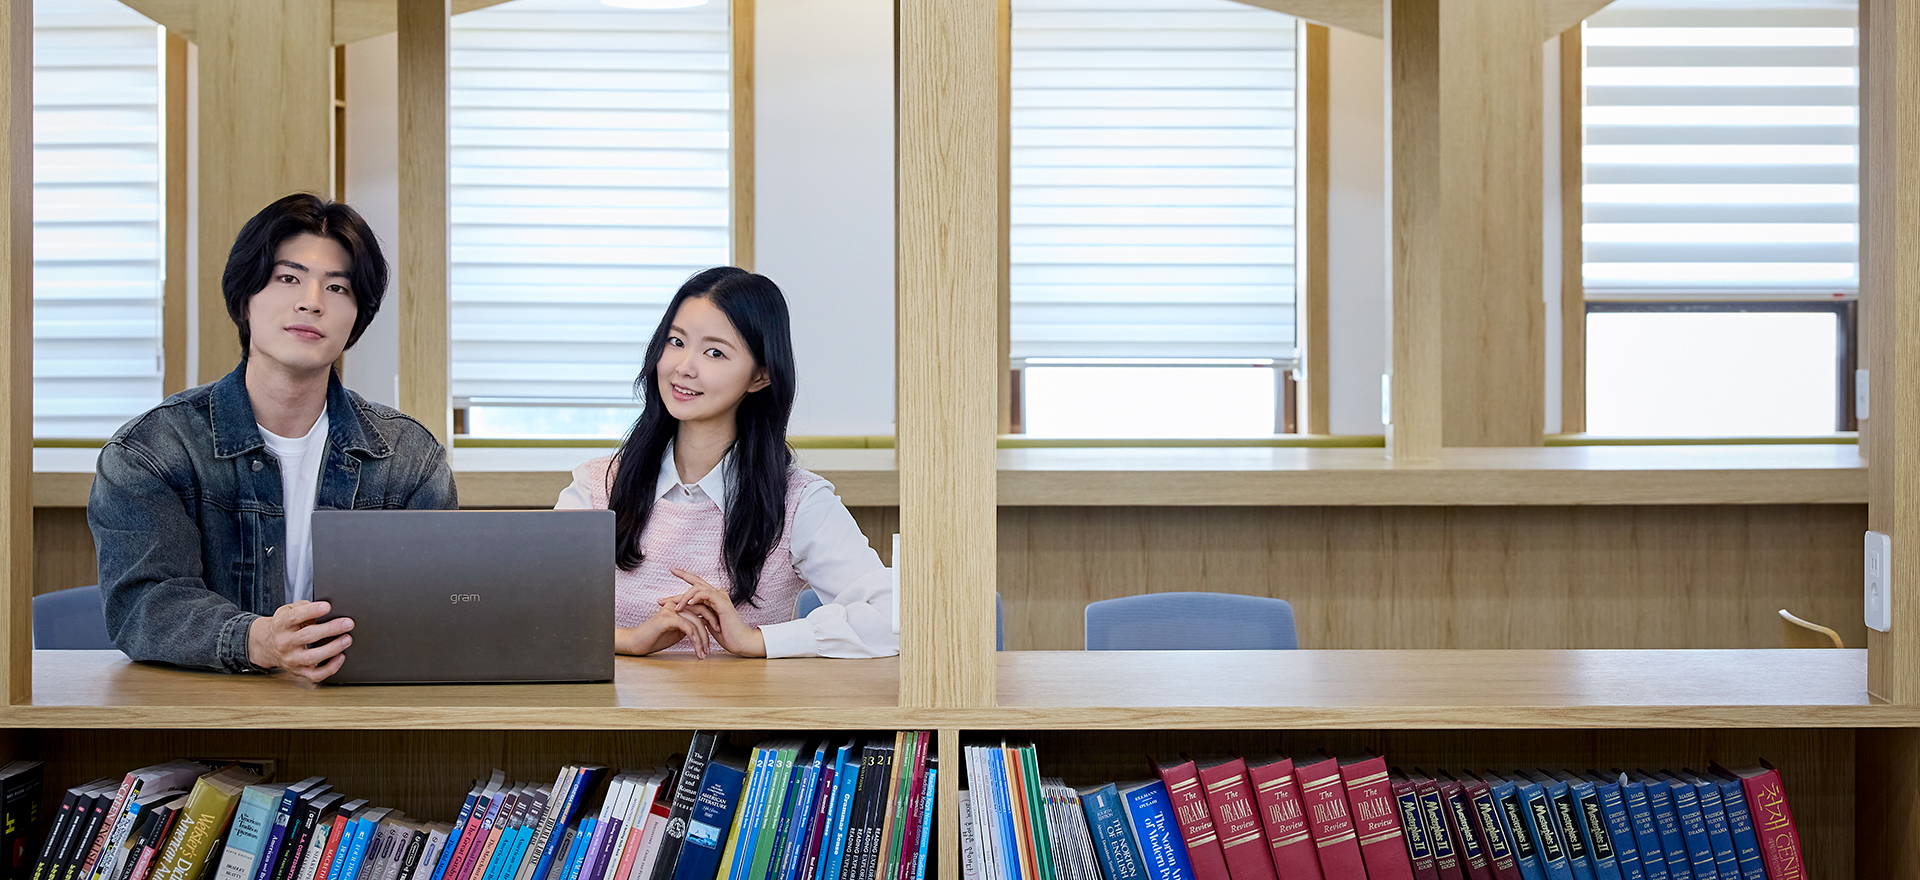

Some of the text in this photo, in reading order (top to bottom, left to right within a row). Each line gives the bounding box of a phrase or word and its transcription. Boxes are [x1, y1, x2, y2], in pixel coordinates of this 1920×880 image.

[450, 593, 481, 605] gram
[694, 751, 704, 760] The
[756, 759, 763, 768] 2
[767, 759, 774, 768] 2
[775, 759, 782, 768] 3
[785, 760, 792, 768] 3
[813, 760, 821, 768] 2
[868, 756, 875, 766] 3
[877, 755, 884, 765] 2
[886, 755, 892, 766] 1
[685, 771, 700, 780] Greek
[825, 779, 831, 787] 1
[921, 771, 929, 795] Reading
[927, 772, 935, 796] Reading
[106, 780, 130, 820] SCREEN
[567, 783, 579, 803] CINEMA
[680, 785, 697, 795] Roman
[702, 793, 727, 804] AMERICAN
[1096, 794, 1105, 808] 1
[1183, 792, 1197, 801] The
[1225, 791, 1239, 800] The
[1274, 790, 1289, 800] The
[1319, 790, 1333, 800] The
[1364, 788, 1378, 798] The
[699, 796, 727, 810] LITERATURE
[823, 784, 838, 837] Grammar Sense
[1178, 800, 1210, 826] DRAMA
[1220, 798, 1253, 824] DRAMA
[1269, 798, 1303, 824] DRAMA
[1313, 797, 1347, 824] DRAMA
[1358, 795, 1392, 822] DRAMA
[1758, 782, 1790, 832] 천재
[832, 792, 850, 856] Grammar Sense
[1143, 816, 1155, 829] of
[1153, 810, 1168, 832] The
[1190, 822, 1213, 834] Review
[1231, 820, 1255, 833] Review
[1280, 820, 1304, 834] Review
[1324, 820, 1348, 834] Review
[1368, 818, 1393, 831] Review
[1402, 801, 1426, 852] Masterplots II
[1425, 800, 1449, 851] Masterplots II
[1453, 801, 1479, 851] Masterplots II
[1478, 802, 1506, 852] Masterplots II
[1505, 803, 1526, 843] Masterplots
[1521, 842, 1532, 852] II
[1534, 804, 1554, 845] Masterplots
[1548, 844, 1560, 854] II
[1558, 802, 1578, 843] Masterplots
[1572, 842, 1583, 852] II
[1584, 802, 1605, 844] Masterplots
[1597, 843, 1610, 852] II
[1688, 828, 1705, 836] DRAMA
[1711, 827, 1728, 836] DRAMA
[1734, 826, 1751, 834] DRAMA
[84, 821, 111, 866] ENGLISH
[161, 812, 198, 865] American
[181, 810, 216, 861] Webster's
[845, 827, 856, 853] READING
[853, 828, 863, 854] READING
[862, 827, 873, 853] READING
[871, 827, 882, 853] READING
[914, 824, 922, 846] Edition
[262, 834, 279, 862] American
[435, 839, 454, 875] The Old Man
[445, 822, 477, 879] The Great Gatsby
[462, 838, 482, 874] Animal Farm
[474, 838, 495, 875] The Merchant
[493, 837, 510, 865] American
[508, 836, 526, 864] American
[1107, 826, 1129, 879] OF ENGLISH
[1112, 818, 1137, 878] THE NORTON
[1147, 828, 1167, 868] Modern
[1159, 831, 1179, 866] Norton
[320, 849, 334, 879] MACBETH
[781, 853, 789, 869] Readings
[910, 852, 918, 875] Student
[917, 854, 925, 877] Student
